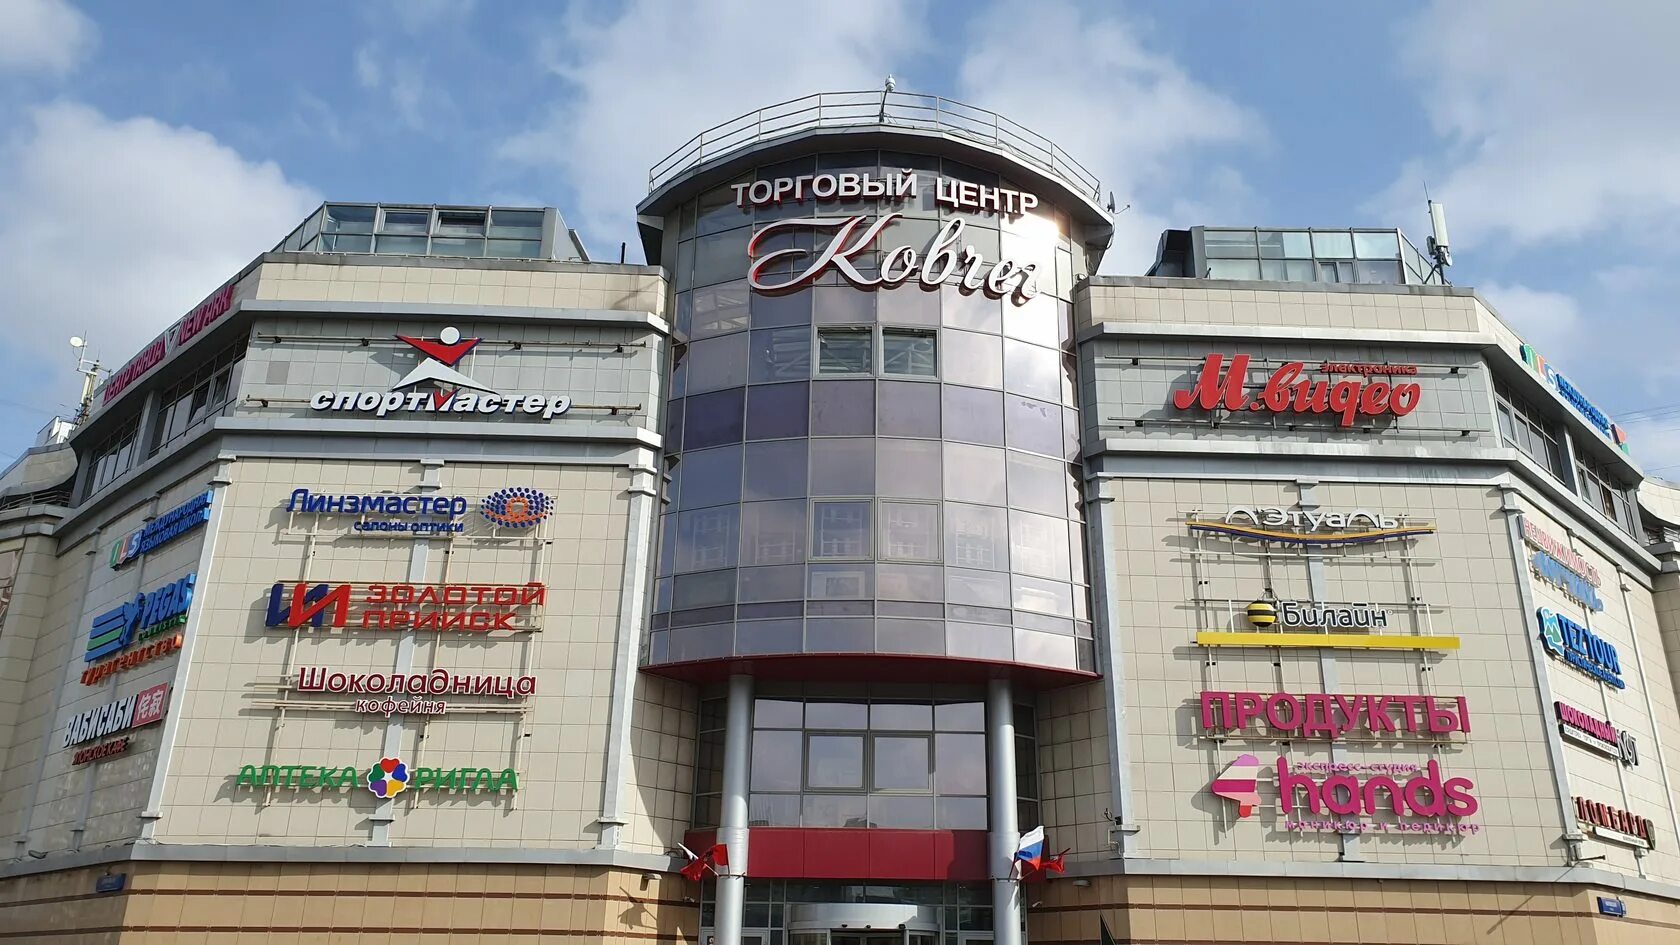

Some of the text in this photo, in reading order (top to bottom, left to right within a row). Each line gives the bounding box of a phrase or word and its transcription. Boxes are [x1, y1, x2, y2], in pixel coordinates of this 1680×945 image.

[731, 168, 1039, 216] ТОРГОВЫЙ ЦЕНТР
[1320, 363, 1418, 378] электроника
[310, 388, 571, 420] спортмастер
[1173, 353, 1421, 428] М.видео
[286, 489, 467, 519] Линзмастер
[354, 521, 464, 533] салоны оптики
[140, 573, 196, 629] PEGAS
[367, 582, 545, 606] ЗОЛОТОЙ
[362, 610, 516, 631] ПРИИСК
[1281, 601, 1388, 628] Билайн
[1556, 613, 1622, 675] TEZ TOUR
[297, 667, 537, 699] Шоколадница
[63, 694, 138, 748] ВАБИСАБИ
[355, 696, 447, 718] кофейня
[1200, 691, 1471, 738] ПРОДУКТЫ
[236, 765, 519, 792] АПТЕКА РИГЛА
[1276, 756, 1478, 817] hands
[1285, 820, 1368, 833] маникюр
[1400, 822, 1480, 834] педикюр
[1576, 796, 1647, 838] ЛОМБАРД
